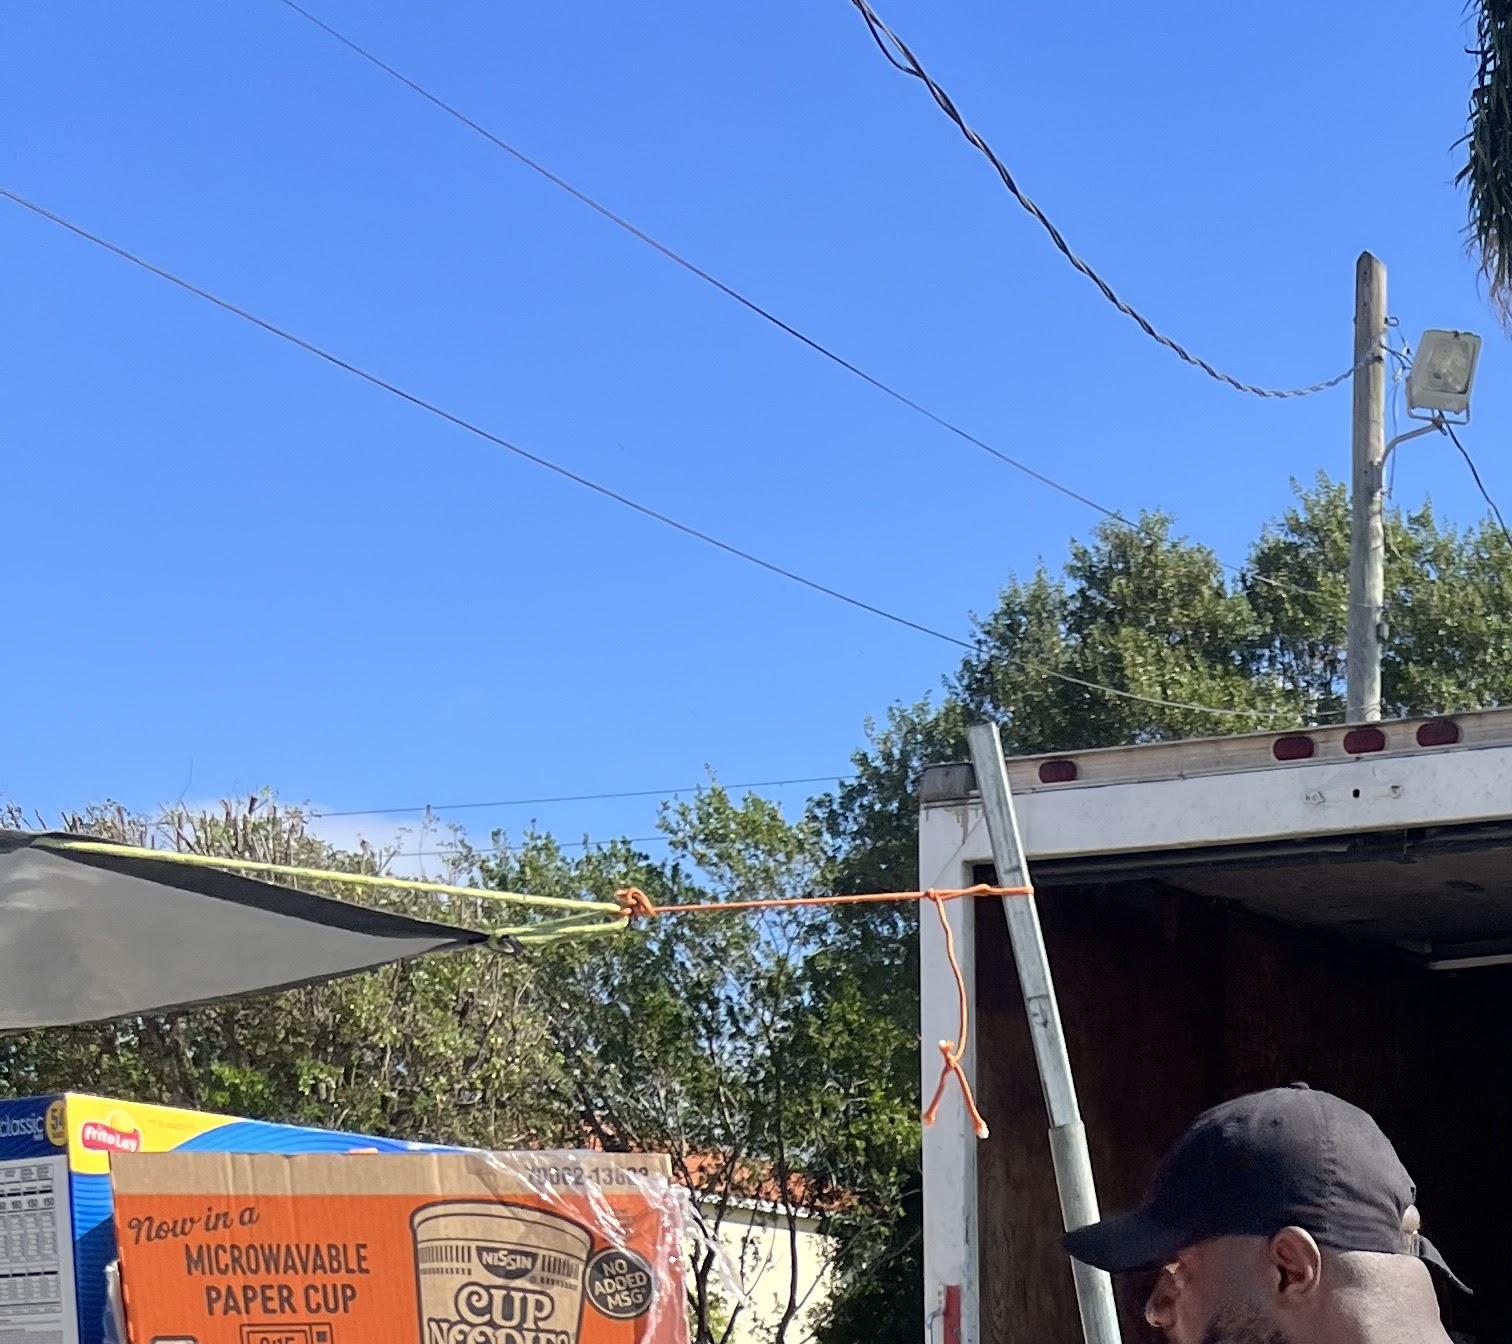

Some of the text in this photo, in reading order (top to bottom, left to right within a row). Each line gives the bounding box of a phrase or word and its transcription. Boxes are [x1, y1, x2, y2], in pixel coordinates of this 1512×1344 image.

[128, 1205, 260, 1245] Now in a
[184, 1243, 370, 1276] MICROWAVABLE
[481, 1249, 533, 1271] NISSIN
[602, 1258, 628, 1276] NO
[594, 1274, 648, 1296] ADDED
[205, 1283, 358, 1316] PAPER CUP
[455, 1283, 554, 1331] CUP
[607, 1294, 644, 1311] MSG
